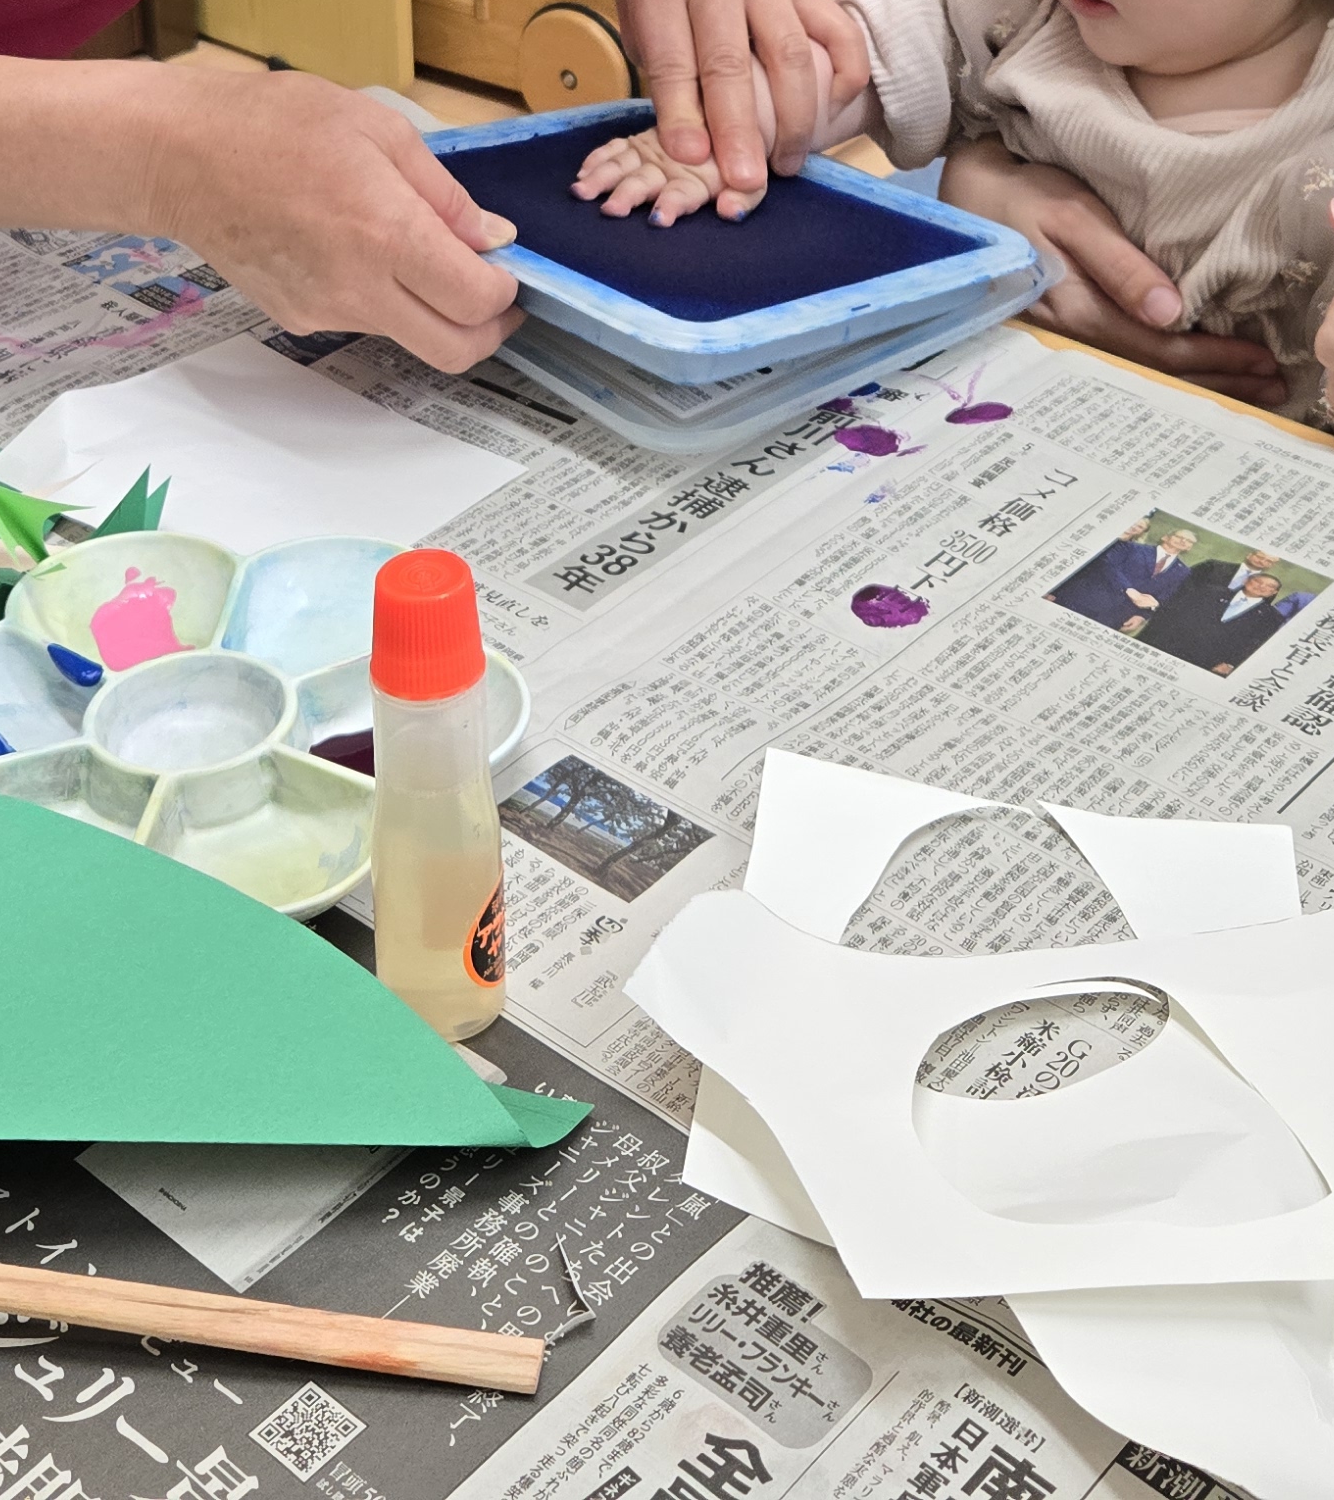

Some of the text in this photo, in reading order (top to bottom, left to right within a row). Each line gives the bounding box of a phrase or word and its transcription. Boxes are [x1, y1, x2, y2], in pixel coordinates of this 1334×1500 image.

[732, 403, 860, 480] 前川さん
[550, 471, 751, 596] 逮捕から38年
[976, 469, 1079, 537] コメ価格
[573, 914, 624, 952] 四季
[940, 851, 1042, 940] 由に関税を発動しているこ
[541, 951, 577, 978] 長谷川
[570, 970, 618, 1008] 『武玉川』
[966, 1016, 1062, 1104] 米縮小検討
[458, 1133, 642, 1294] 母メリーとの確執、
[467, 1151, 667, 1326] 叔父ジャニーのこと、
[708, 1282, 834, 1376] 糸井重里 さん
[739, 1262, 822, 1323] 推薦!
[659, 1324, 788, 1425] 養老孟司 さん
[689, 1305, 845, 1424] リリー・フランキー さん
[591, 1385, 686, 1479] 6歳から82歳まで、
[953, 1383, 1045, 1452] 【新潮選書】
